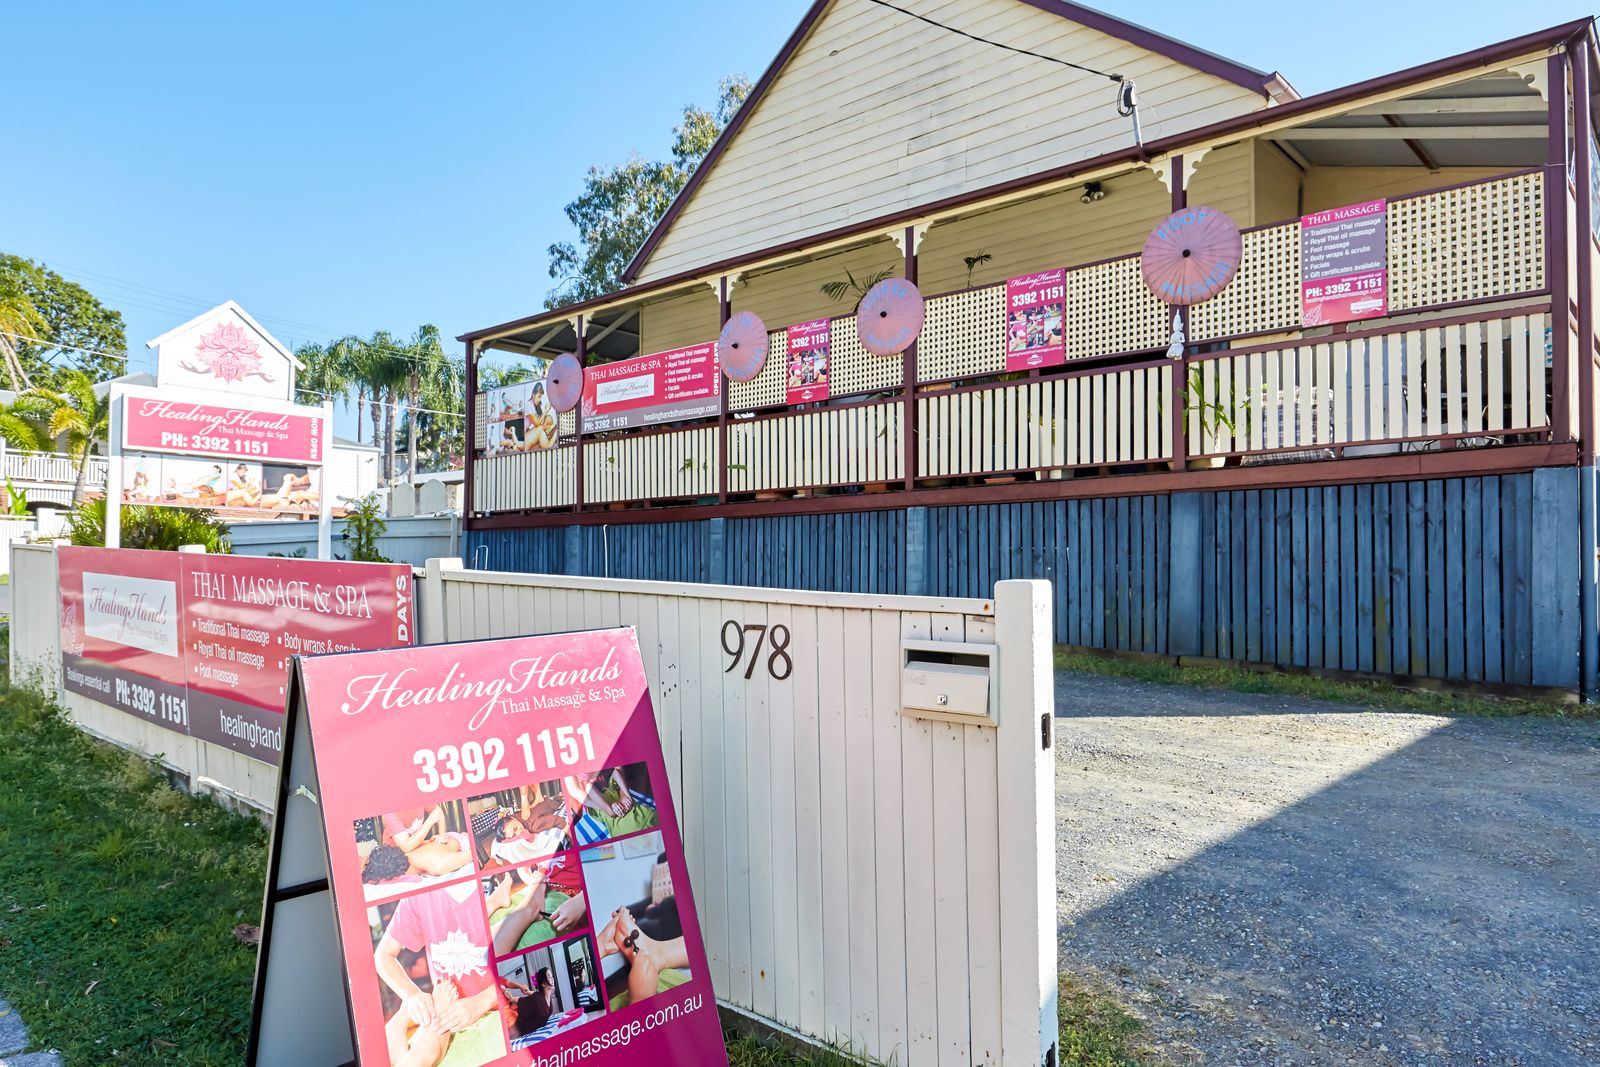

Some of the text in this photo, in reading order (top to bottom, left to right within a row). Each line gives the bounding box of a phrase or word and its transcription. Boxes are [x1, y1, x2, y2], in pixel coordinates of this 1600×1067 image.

[1307, 203, 1381, 225] THAI MASSAGE
[1310, 218, 1381, 236] Traditional Thai massage
[1310, 237, 1327, 246] Royal
[1327, 233, 1340, 241] Thai
[1349, 228, 1376, 238] massage
[1310, 253, 1325, 262] Body
[1326, 249, 1344, 259] wraps
[1351, 246, 1371, 255] scrubs
[1324, 241, 1350, 251] massage
[1310, 262, 1330, 270] Facials
[1310, 261, 1381, 279] Gift certificates available
[1012, 285, 1064, 307] 3392 1151
[1306, 287, 1323, 298] PH:
[1325, 282, 1352, 295] 3392
[1356, 277, 1382, 290] 1151
[791, 332, 829, 349] 3392 1151
[591, 370, 606, 380] THAI
[608, 363, 640, 377] MASSAGE
[648, 360, 661, 369] SPA
[139, 400, 290, 436] Healing Hands
[595, 418, 610, 430] 3392
[613, 416, 628, 427] 1151
[161, 432, 269, 455] PH: 3392 1151
[218, 425, 289, 440] Thai Massage & Spa
[310, 417, 319, 459] NOW OPEN
[191, 571, 372, 619] THAI MASSAGE & SPA
[89, 588, 130, 640] Healing
[128, 593, 167, 625] Hands
[396, 574, 409, 642] DAYS
[197, 618, 270, 647] Traditional Thai massage
[284, 632, 302, 653] Body
[303, 638, 325, 654] wraps
[327, 639, 334, 653] &
[198, 640, 213, 658] Royal
[214, 643, 227, 659] Thai
[236, 650, 265, 670] massage
[721, 619, 793, 681] 978
[199, 663, 238, 687] Foot massage
[341, 646, 623, 731] Healing Hands
[498, 685, 626, 715] Thai Massage & Spa
[115, 678, 188, 726] PH: 3392 1151
[220, 709, 282, 752] healinghand
[412, 722, 596, 793] 3392 1151
